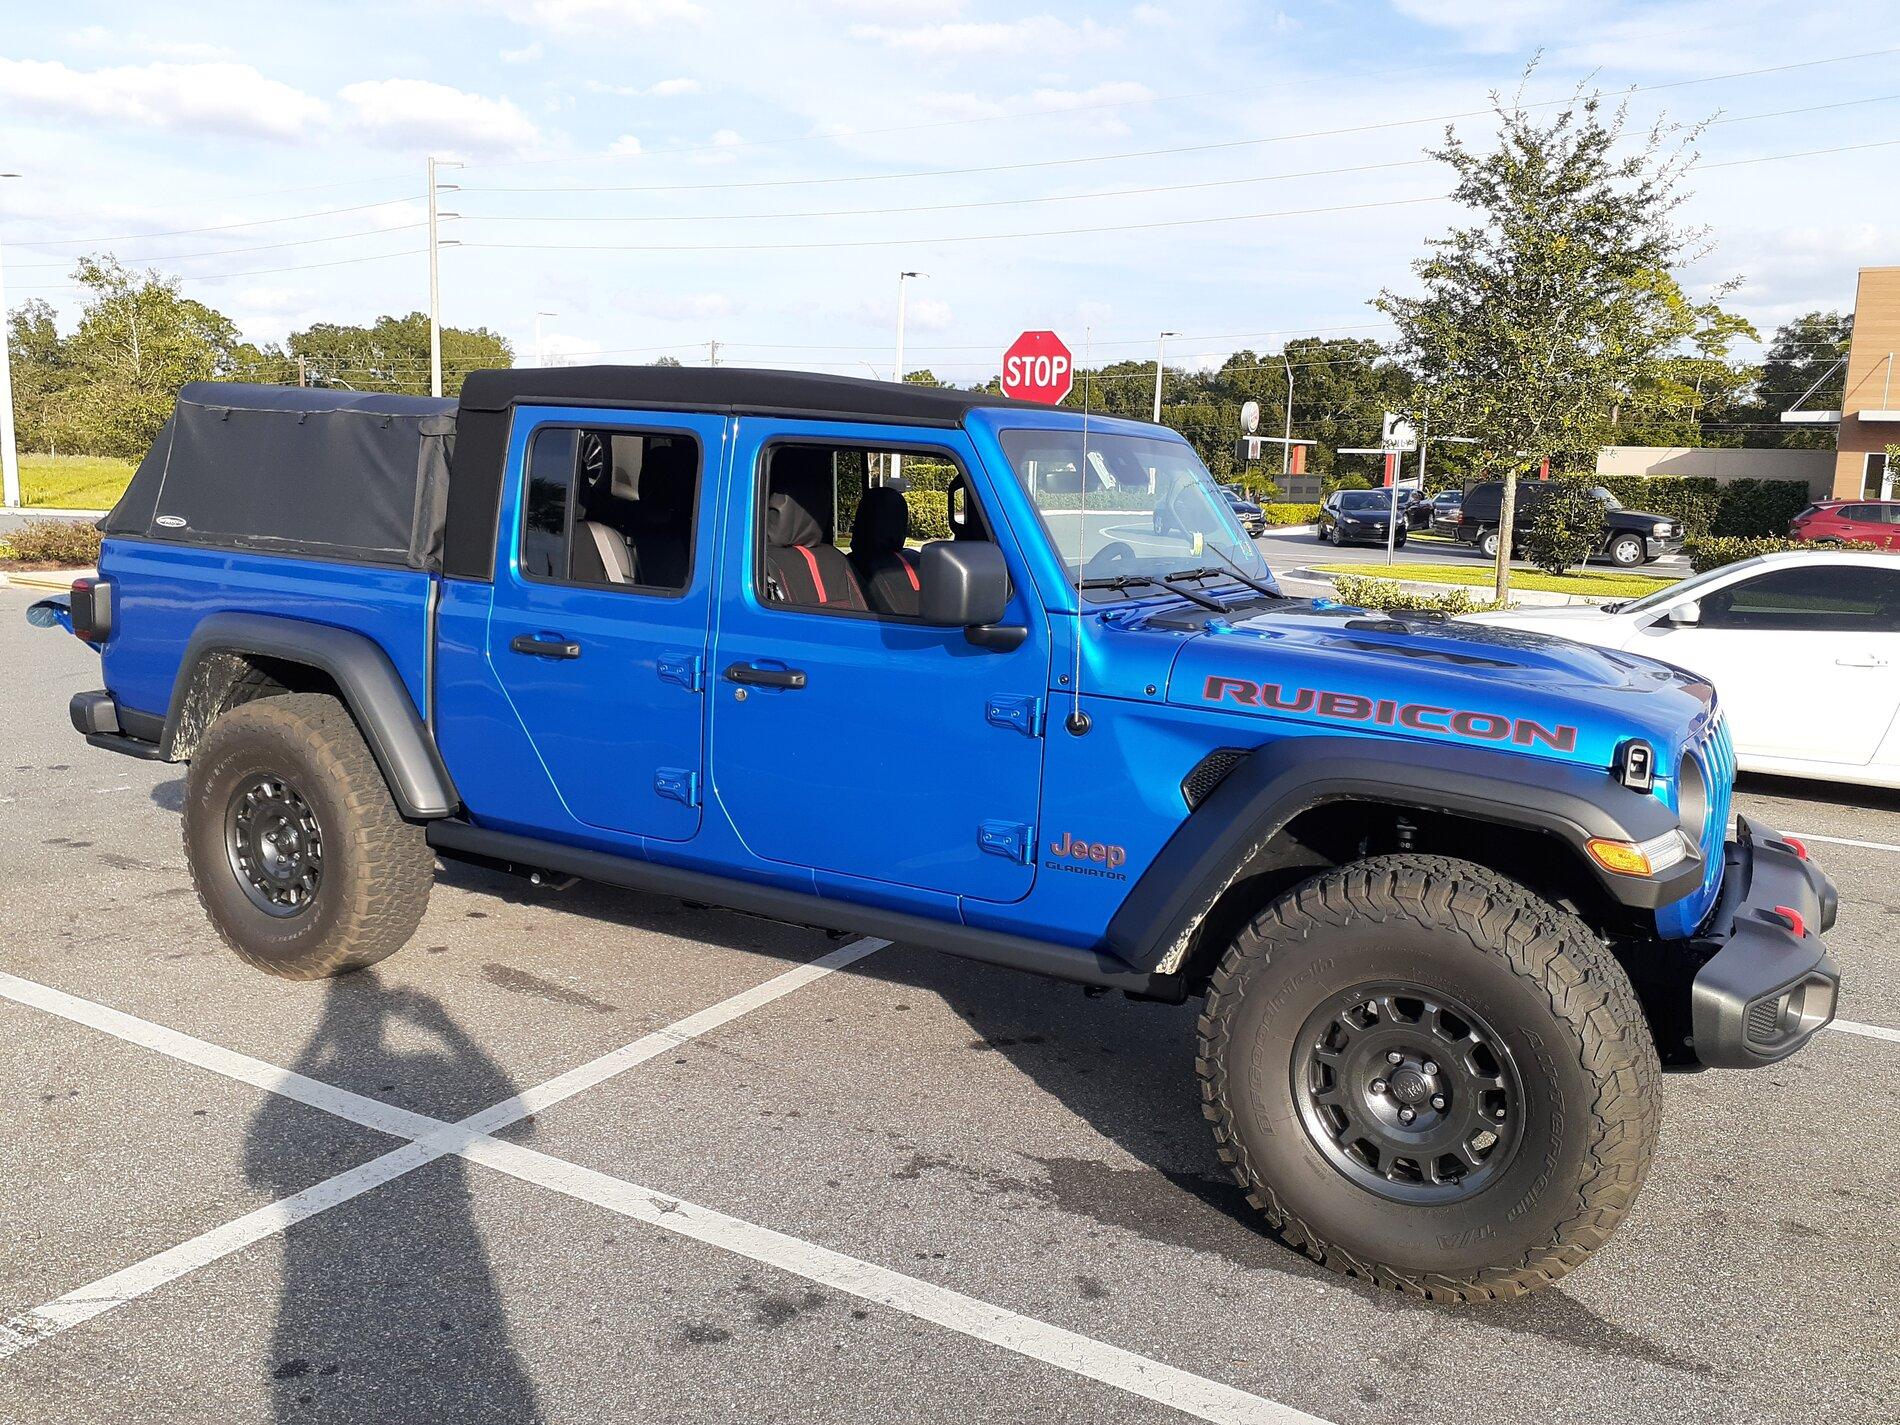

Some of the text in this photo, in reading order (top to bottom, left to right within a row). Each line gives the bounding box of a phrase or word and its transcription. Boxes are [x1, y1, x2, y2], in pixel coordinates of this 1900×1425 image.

[1006, 355, 1068, 387] STOP
[1202, 675, 1578, 753] RUBICON
[1050, 831, 1126, 869] Jeep
[1045, 860, 1127, 882] GLADIATOR
